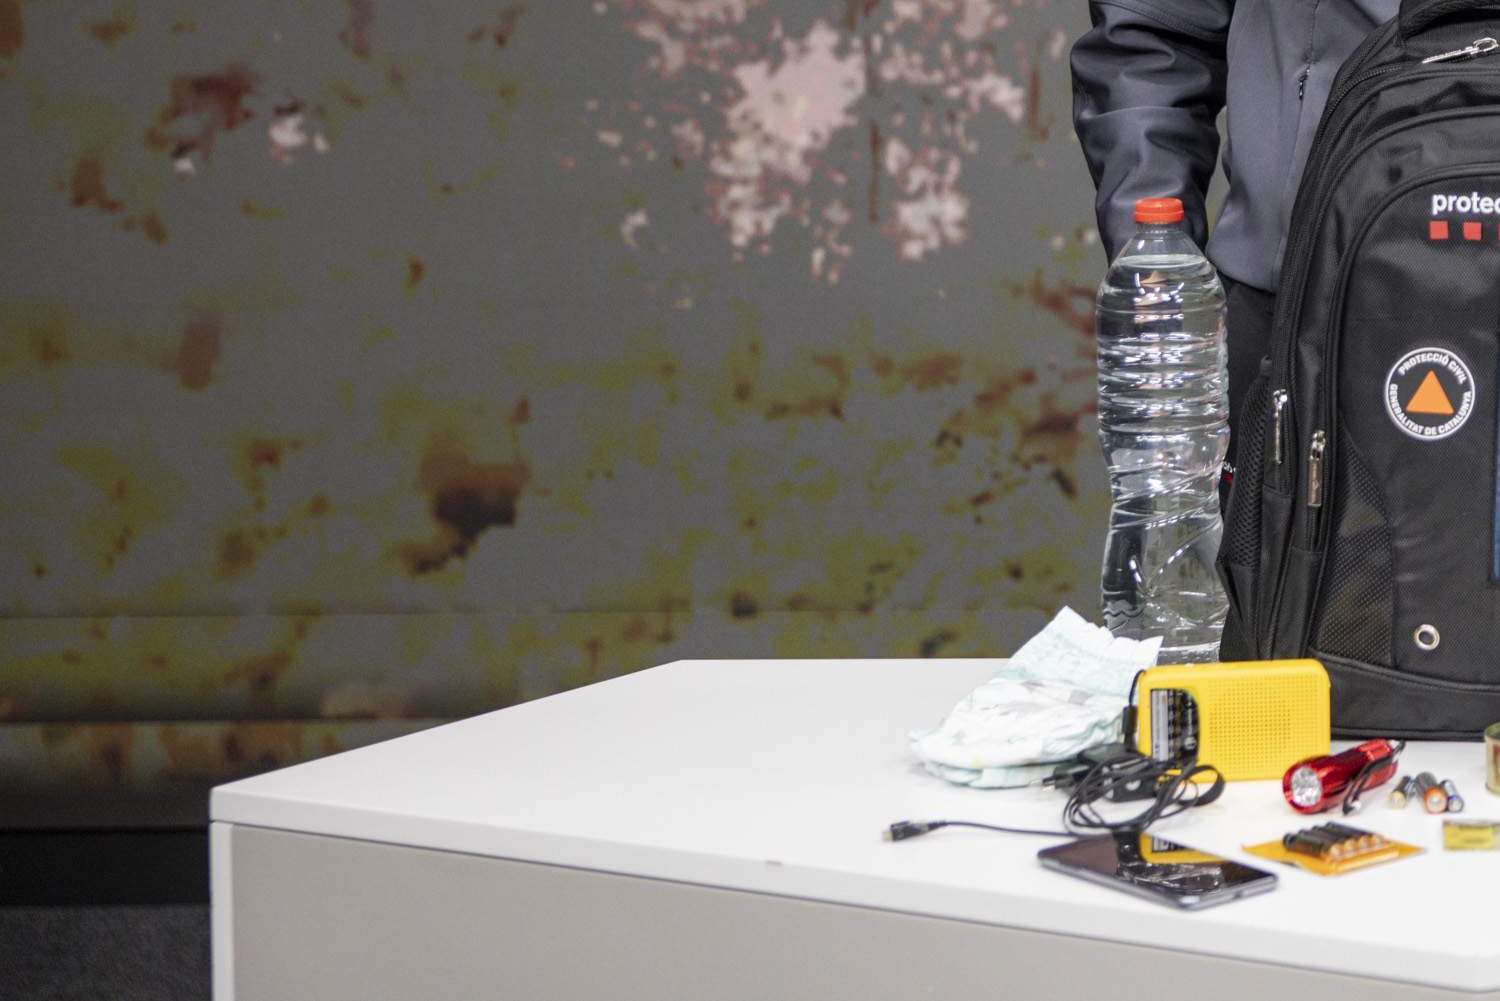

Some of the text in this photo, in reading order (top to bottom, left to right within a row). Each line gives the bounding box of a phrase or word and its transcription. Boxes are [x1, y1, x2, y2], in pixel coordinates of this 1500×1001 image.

[1397, 352, 1467, 385] PROTECCIÓ CIVIL
[1389, 383, 1472, 436] GENERALITAT DE CATALUNYA
